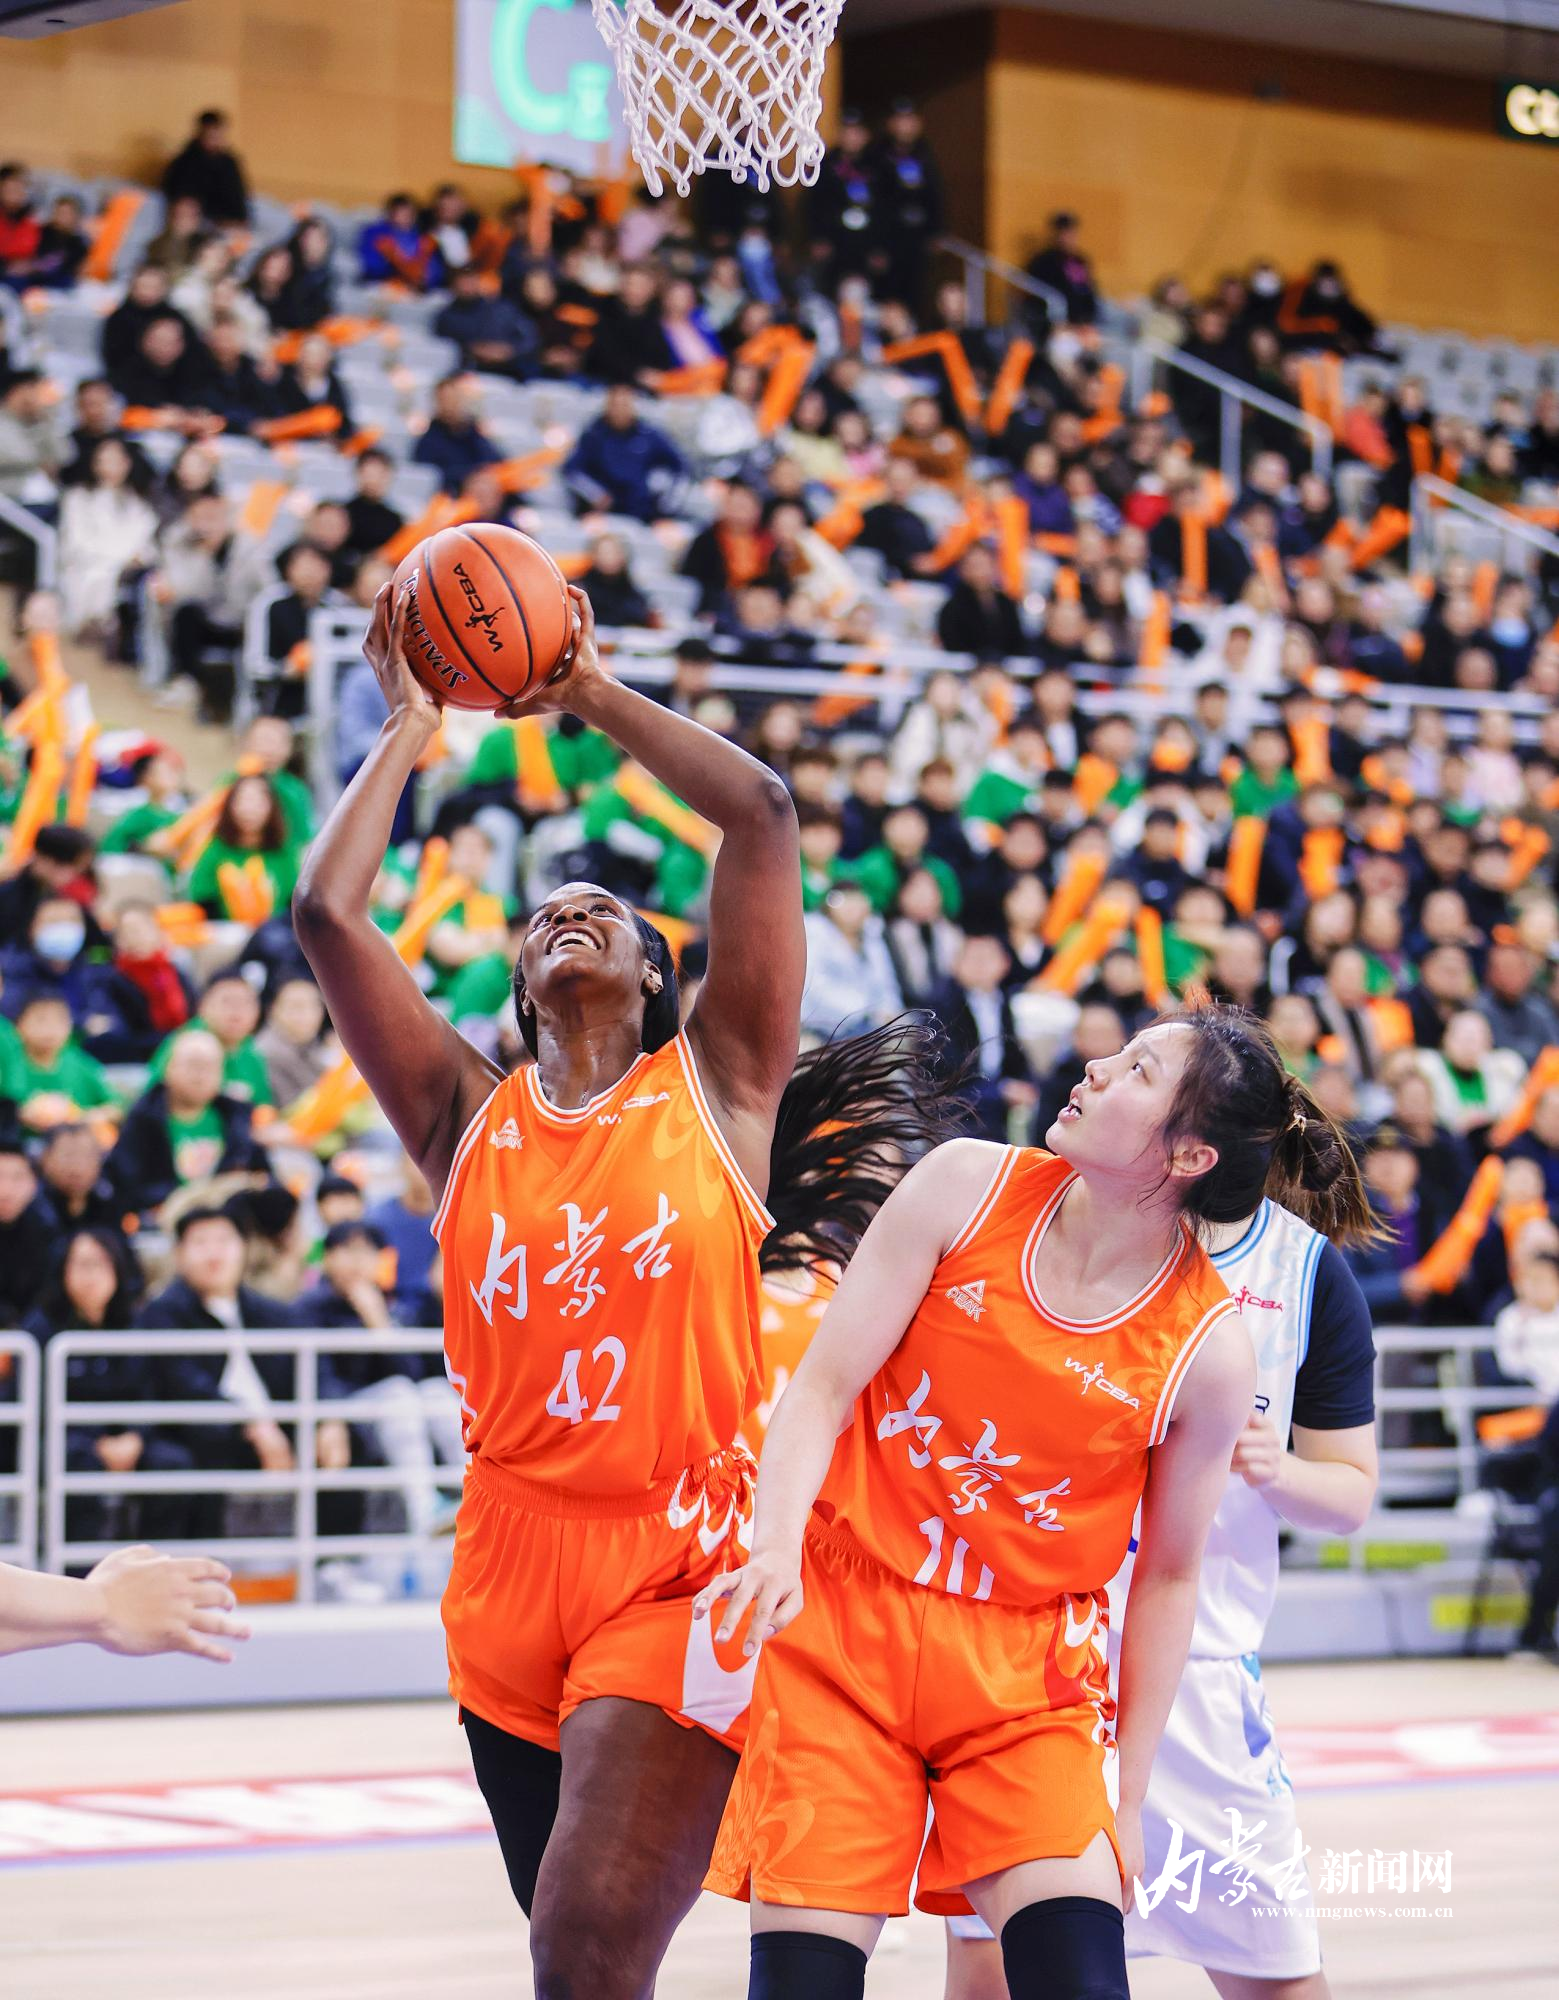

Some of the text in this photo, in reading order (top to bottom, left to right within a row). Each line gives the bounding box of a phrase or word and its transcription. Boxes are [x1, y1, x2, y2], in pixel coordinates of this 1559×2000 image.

[453, 563, 505, 653] WCBA
[469, 1191, 680, 1328] 内蒙古
[945, 1285, 987, 1323] PEAK
[545, 1335, 627, 1425] 42
[1063, 1356, 1140, 1411] WCBA
[876, 1368, 1072, 1532] 内蒙古
